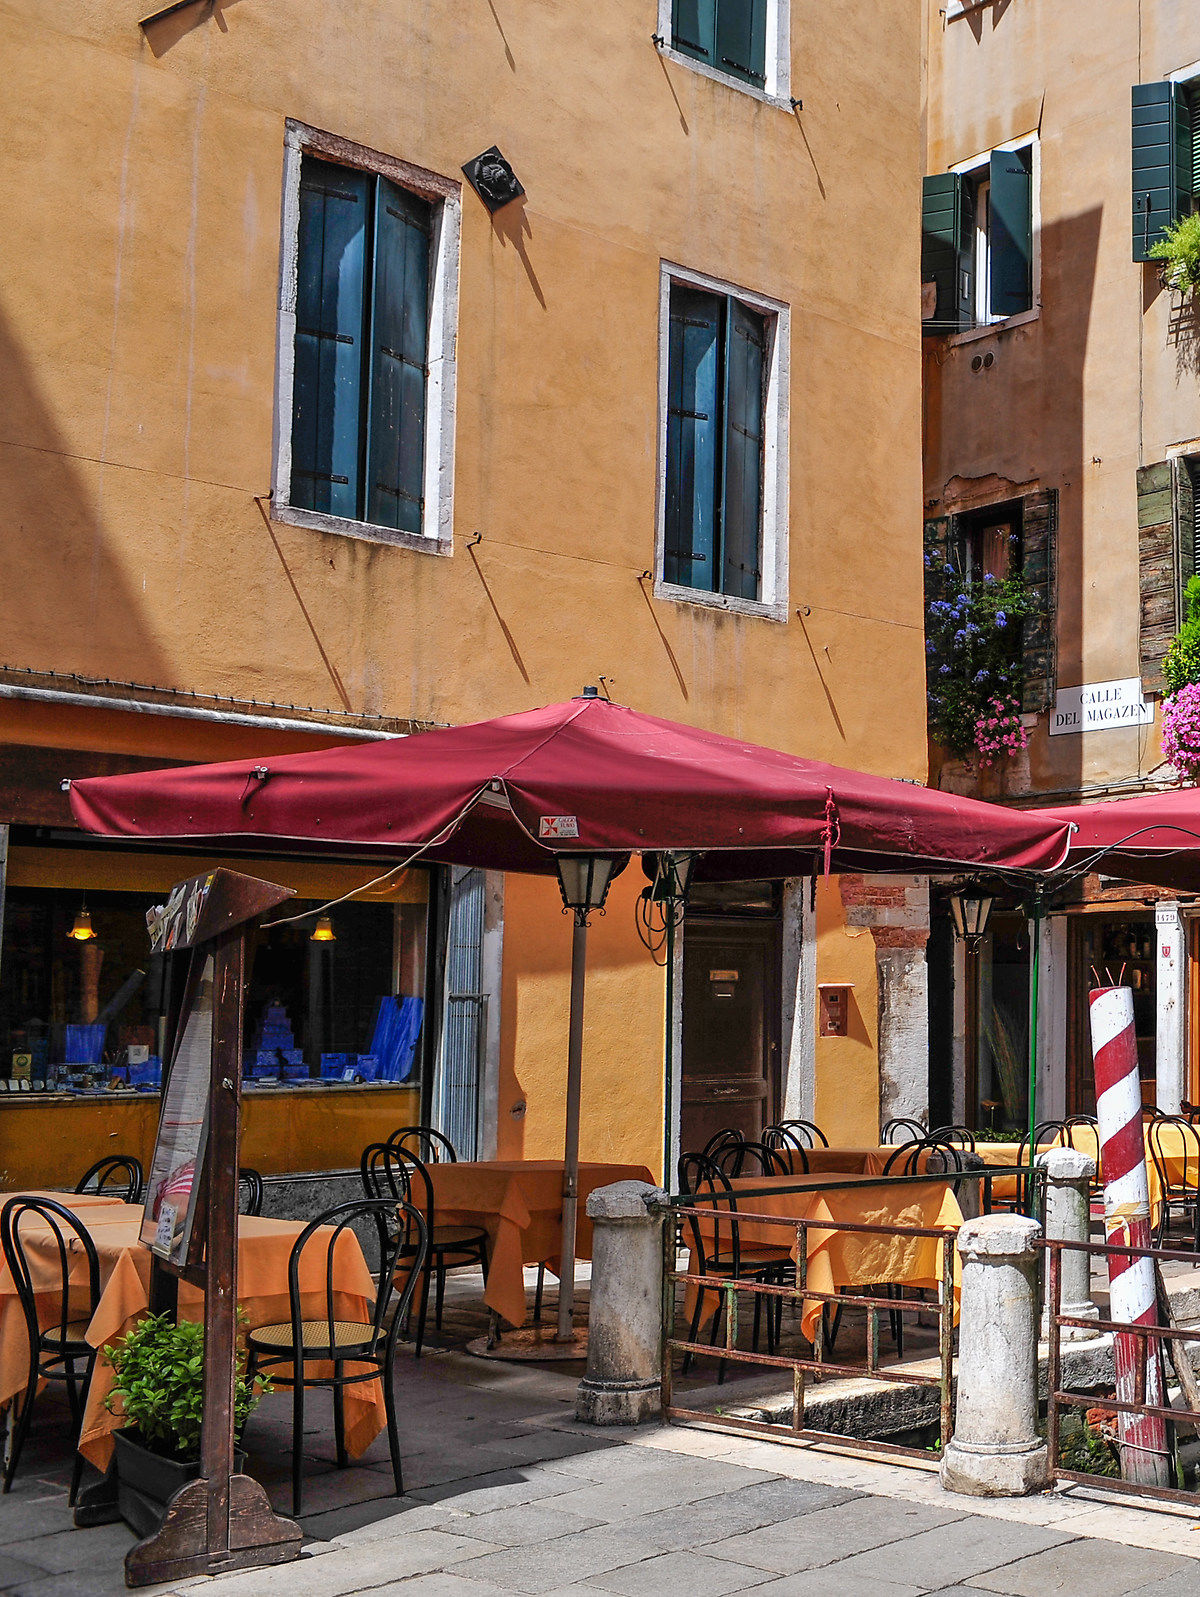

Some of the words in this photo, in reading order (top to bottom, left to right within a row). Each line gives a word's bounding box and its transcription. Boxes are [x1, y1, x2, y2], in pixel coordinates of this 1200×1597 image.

[1080, 687, 1122, 705] CALLE
[1056, 712, 1081, 727] DEL
[1087, 703, 1147, 722] MAGAZEN
[1157, 914, 1175, 922] 1479
